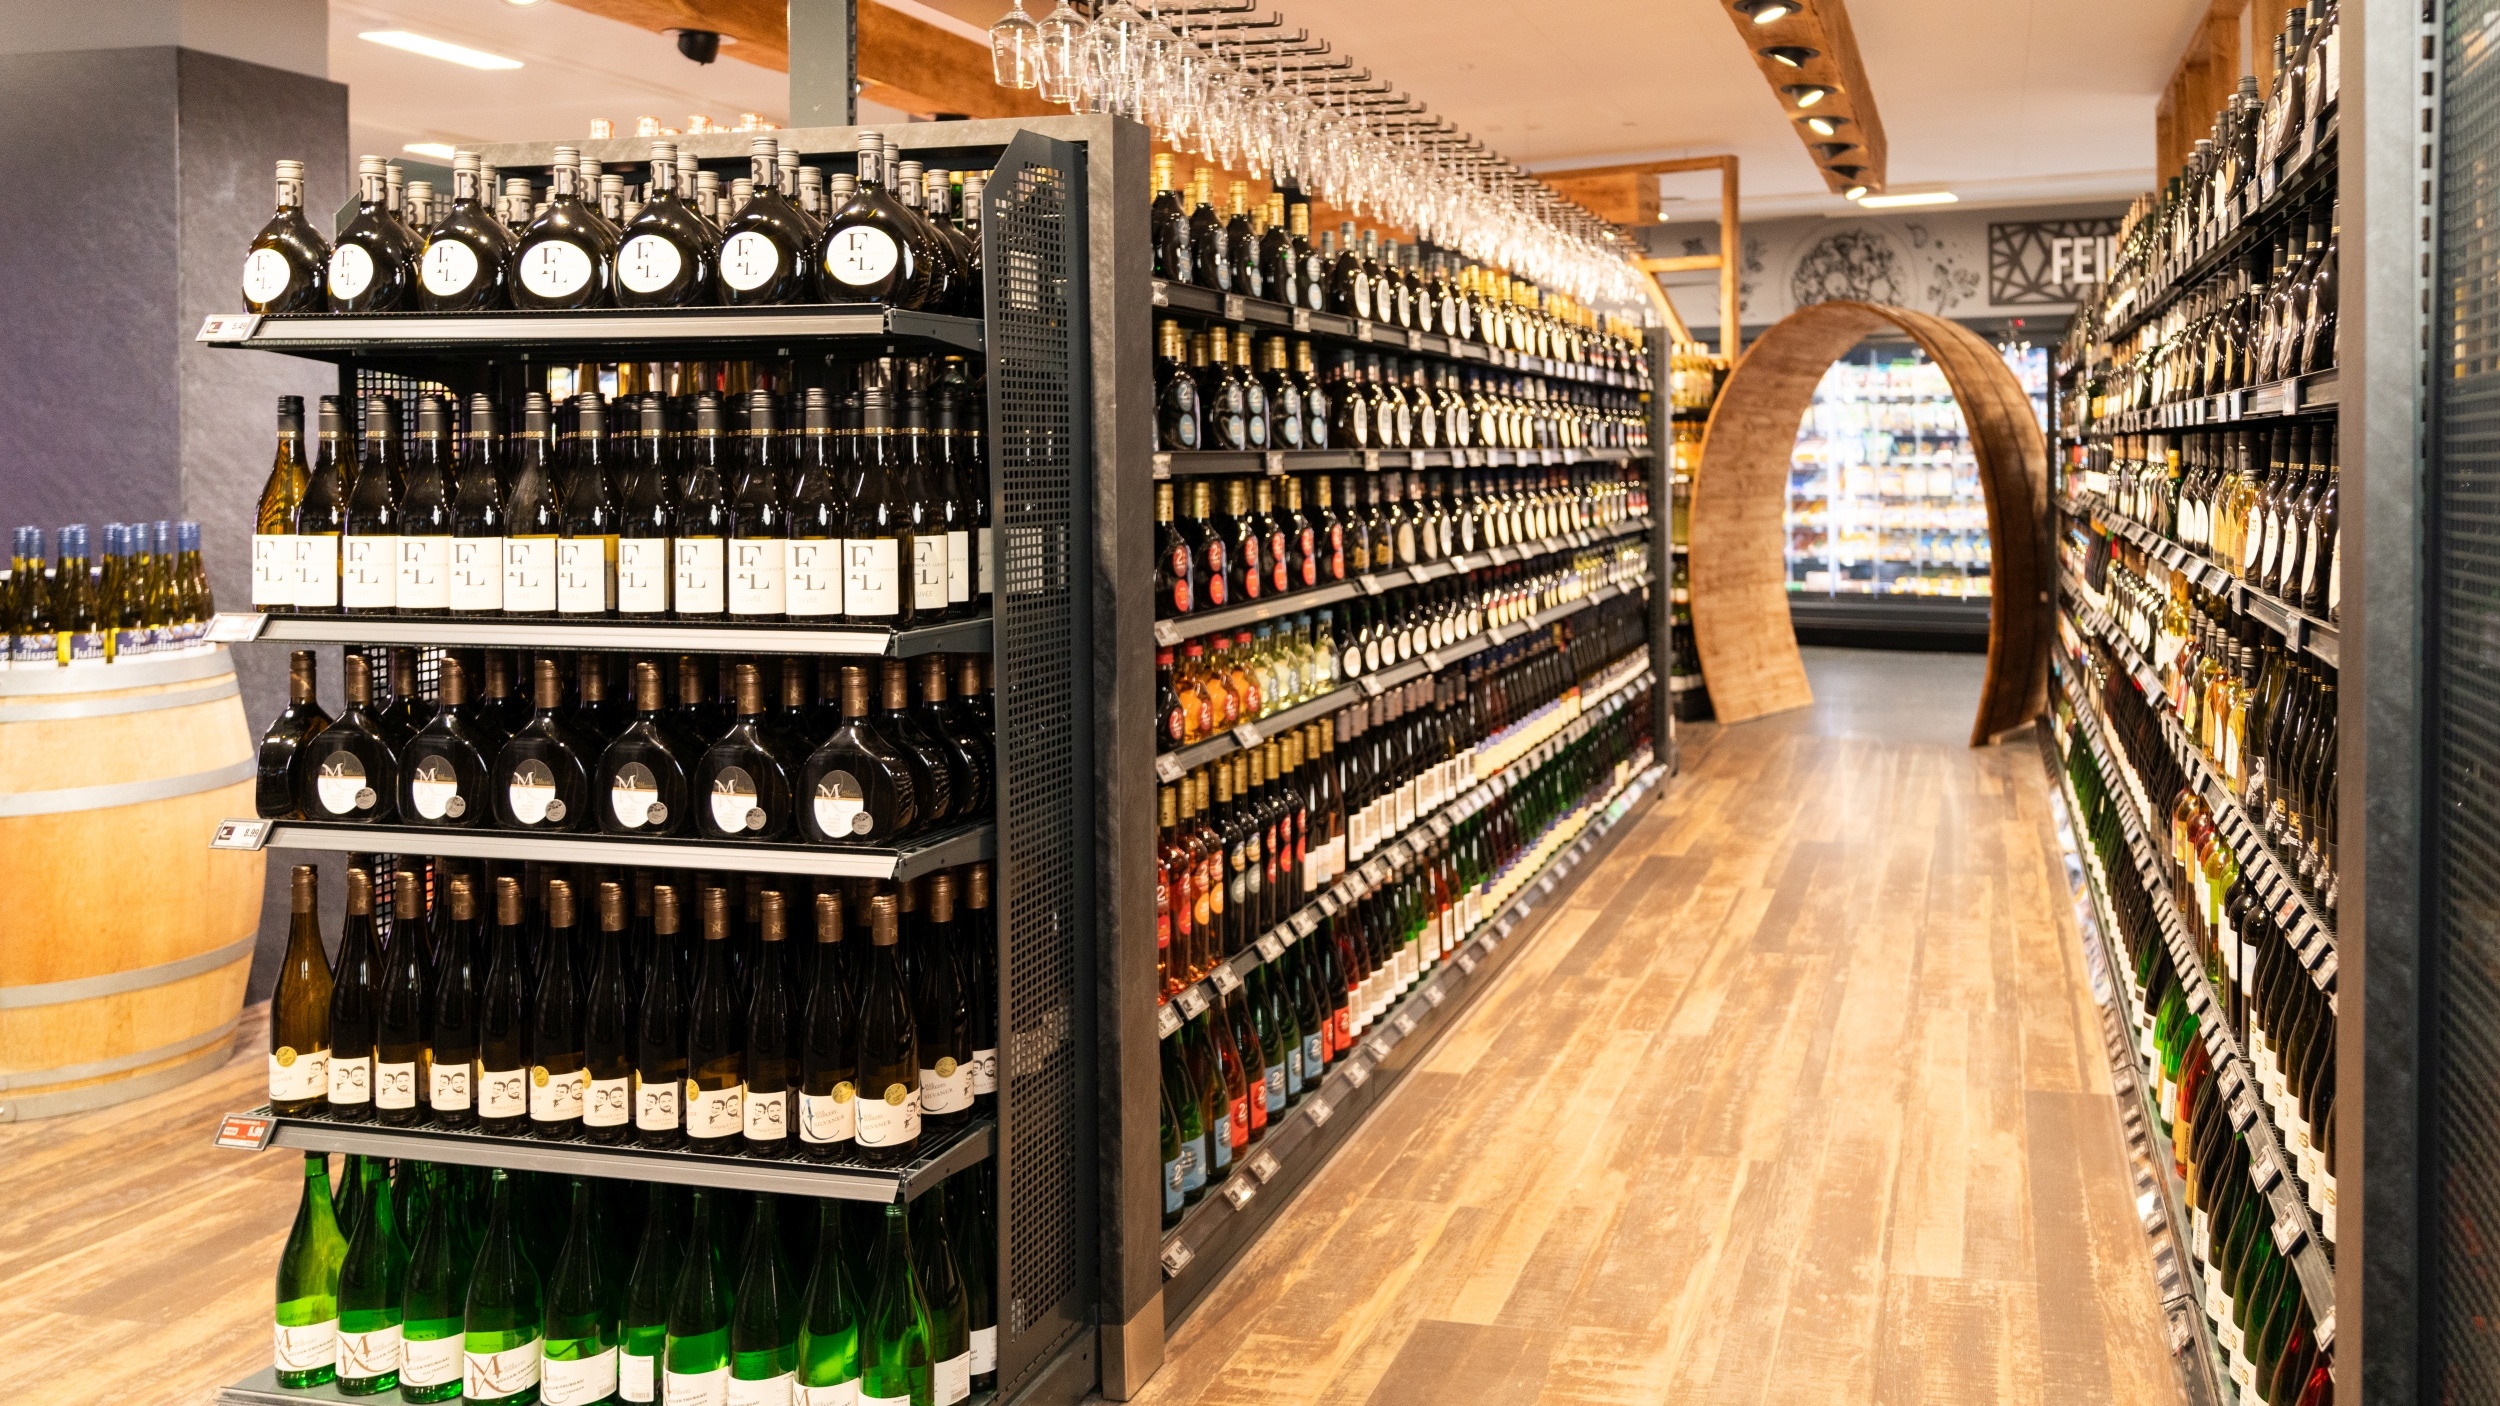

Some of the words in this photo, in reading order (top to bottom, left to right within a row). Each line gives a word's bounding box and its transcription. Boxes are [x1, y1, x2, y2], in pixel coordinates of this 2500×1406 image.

[321, 762, 343, 777] M
[416, 767, 437, 782] M
[513, 771, 534, 786] M
[615, 774, 636, 791] M
[714, 779, 736, 794] M
[818, 783, 841, 798] M
[243, 828, 260, 837] 8.99
